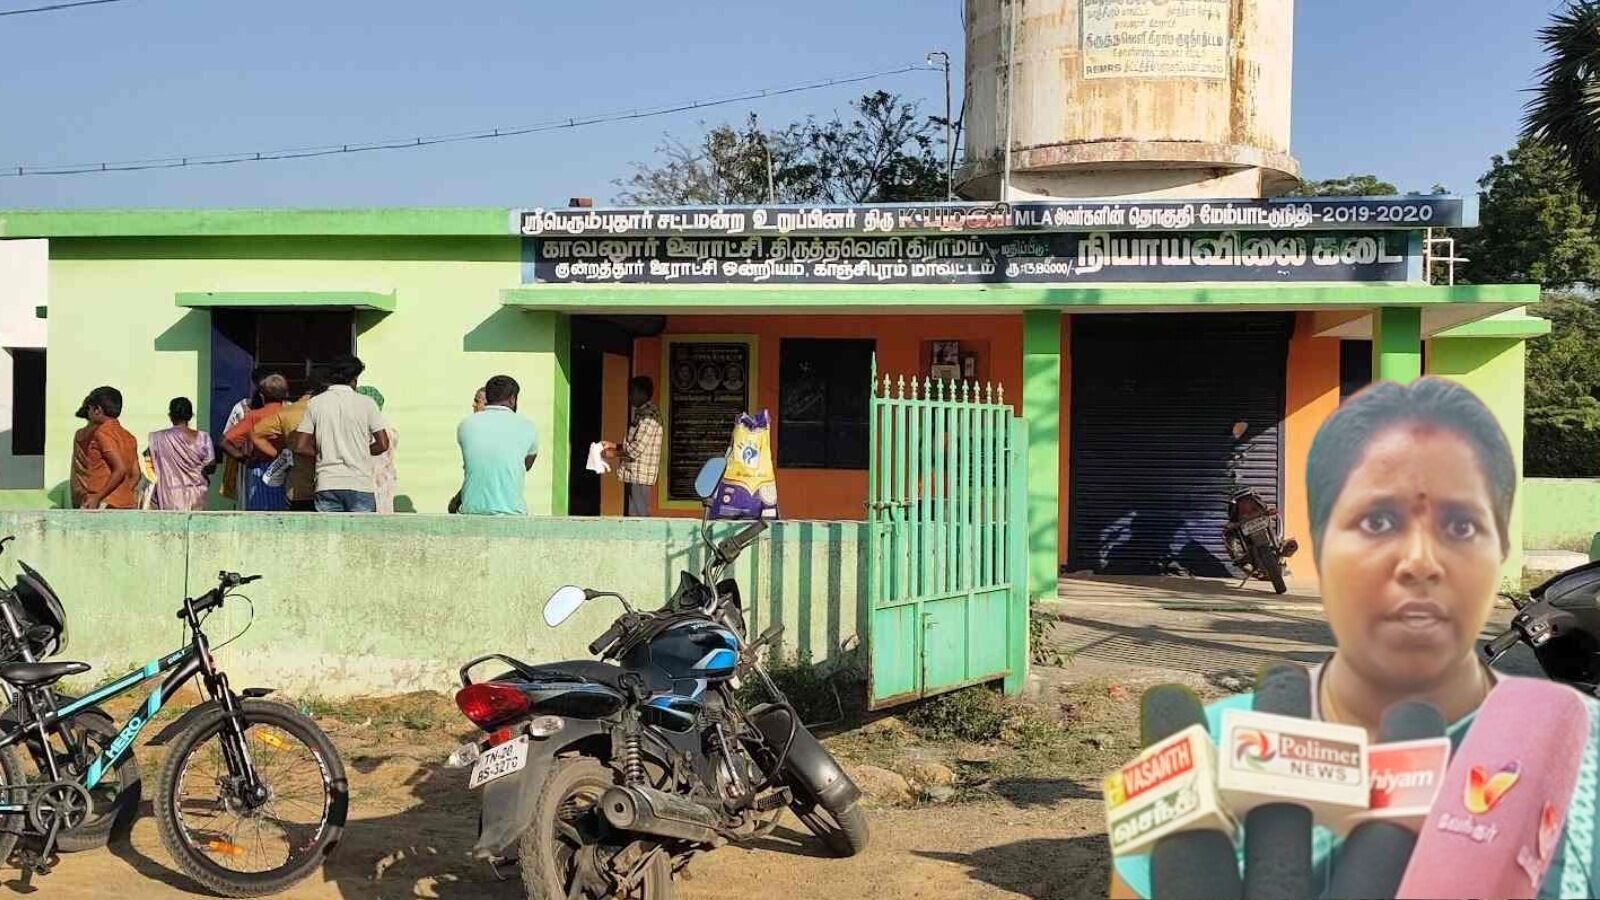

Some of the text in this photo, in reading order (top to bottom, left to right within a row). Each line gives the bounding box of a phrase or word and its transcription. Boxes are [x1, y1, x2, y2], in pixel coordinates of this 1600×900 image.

[521, 207, 655, 234] ஸ்ரீபெரும்புதூர்
[657, 209, 745, 233] சட்டமன்ற
[752, 208, 857, 233] உறுப்பினர்
[863, 208, 895, 232] திரு
[1015, 209, 1053, 227] MLA
[1054, 204, 1126, 227] அவர்களின்
[1129, 204, 1195, 229] தொகுதி
[542, 236, 660, 262] காவனூர்
[1312, 236, 1403, 266] கடை
[555, 259, 645, 280] குன்றத்தூர்
[650, 258, 718, 280] ஊராட்சி
[813, 259, 907, 281] காஞ்சிபுரம்
[910, 259, 996, 278] மாவட்டம்
[105, 715, 143, 760] HERO
[1281, 736, 1359, 766] Polimer
[1125, 741, 1191, 794] VASANTH
[1290, 761, 1347, 781] NEWS
